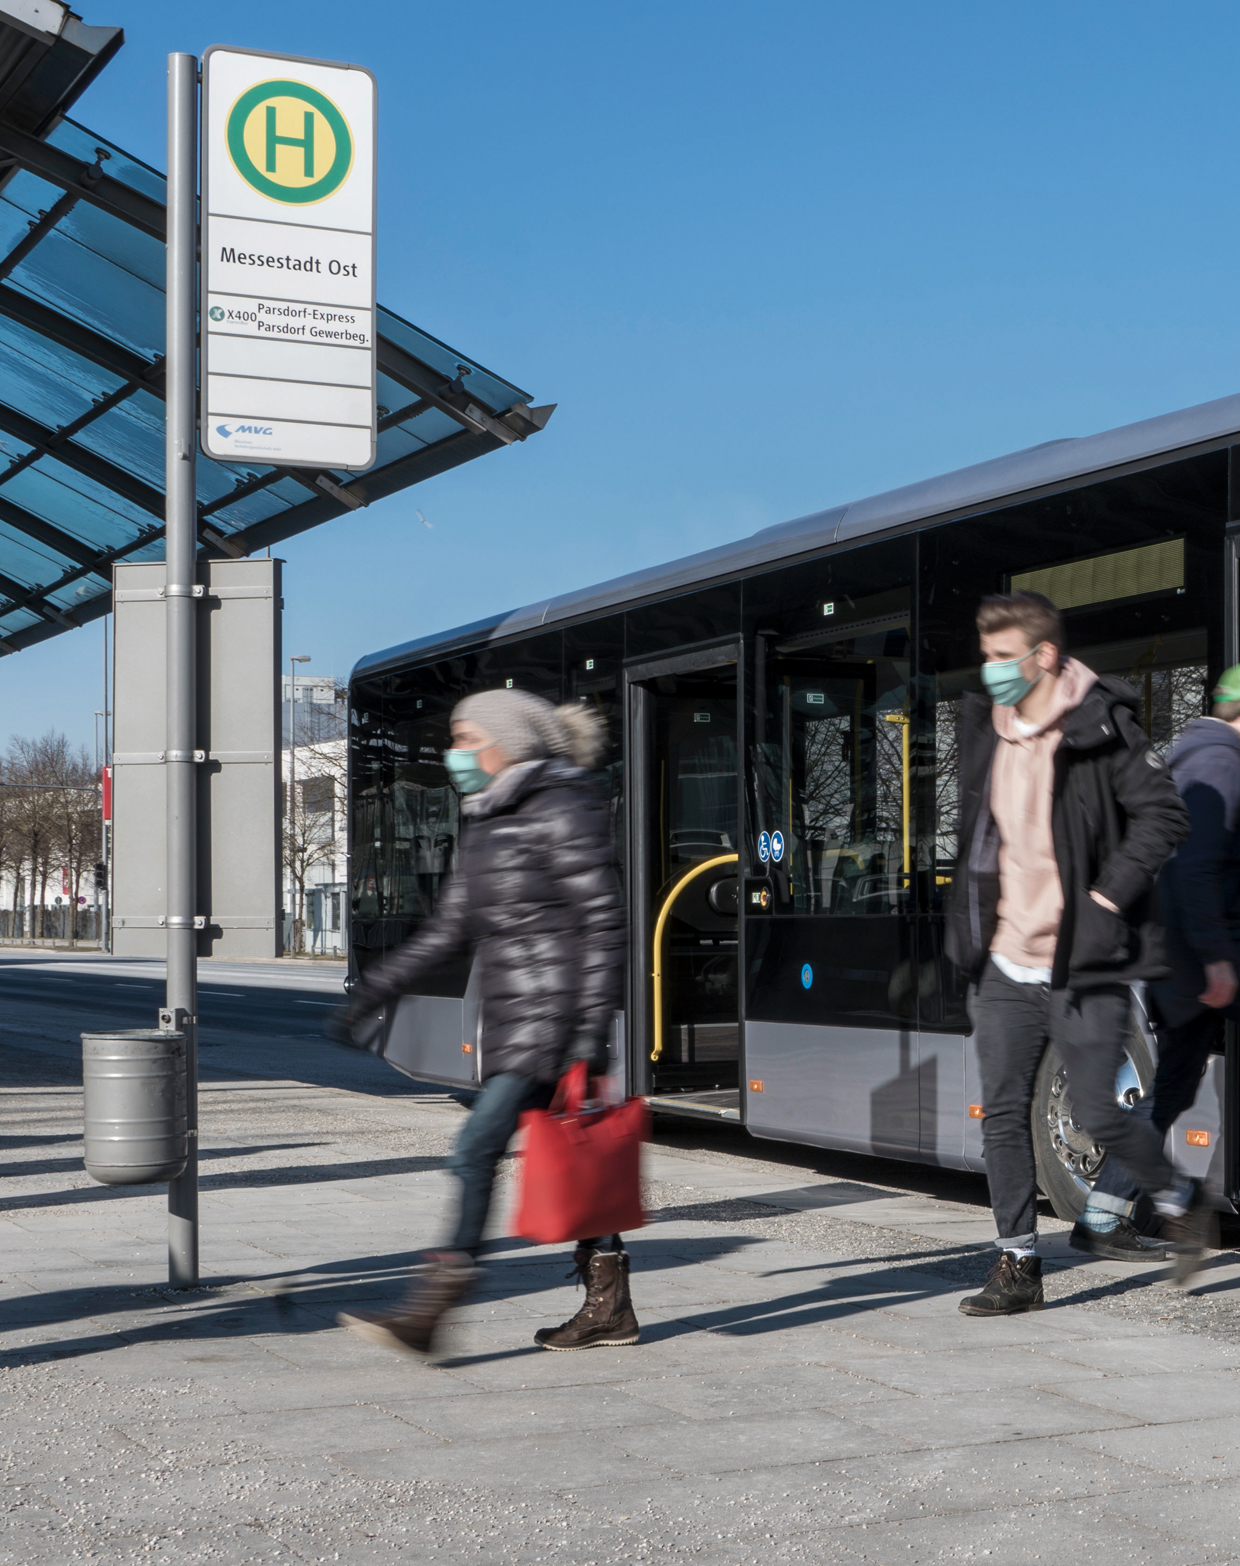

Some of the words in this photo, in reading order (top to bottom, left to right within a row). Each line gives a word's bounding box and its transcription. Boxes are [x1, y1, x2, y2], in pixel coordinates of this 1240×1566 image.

[265, 105, 315, 178] H
[220, 247, 322, 274] Messestadt
[328, 259, 358, 278] Ost
[227, 309, 257, 322] X400
[257, 303, 356, 324] Parsdorf-Express
[257, 320, 306, 337] Parsdorf
[309, 326, 370, 344] Gewerbeg.
[235, 425, 273, 436] MVG
